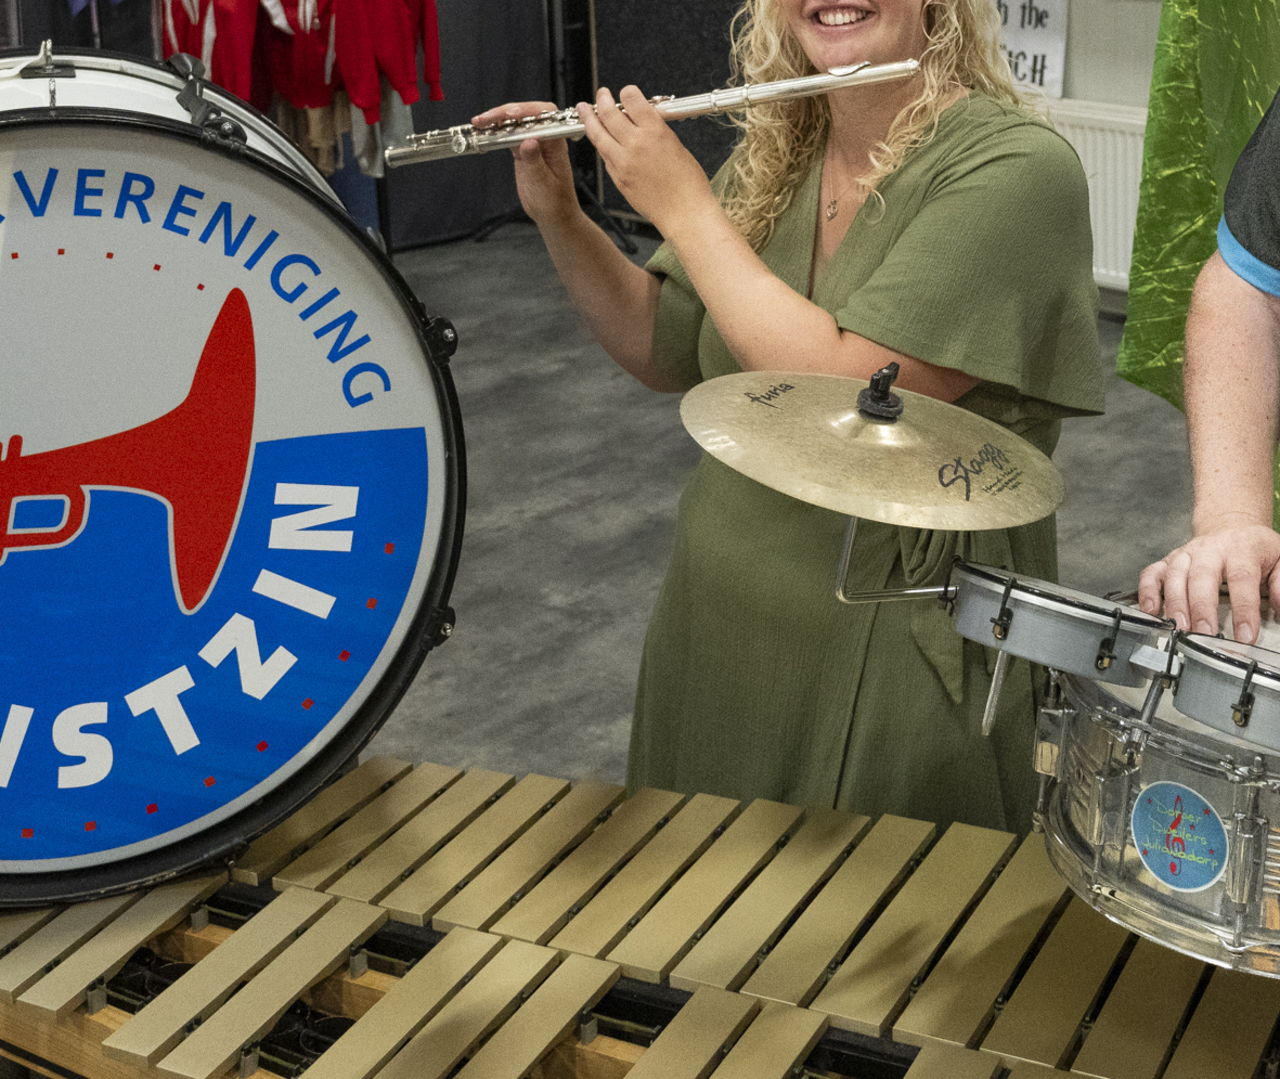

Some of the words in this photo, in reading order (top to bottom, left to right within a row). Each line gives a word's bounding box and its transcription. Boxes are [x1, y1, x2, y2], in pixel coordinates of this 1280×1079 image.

[937, 441, 1011, 502] Stagg
[1151, 795, 1203, 825] Dorper
[1147, 814, 1209, 846] Dweilers
[1141, 834, 1219, 872] Julianadorp
